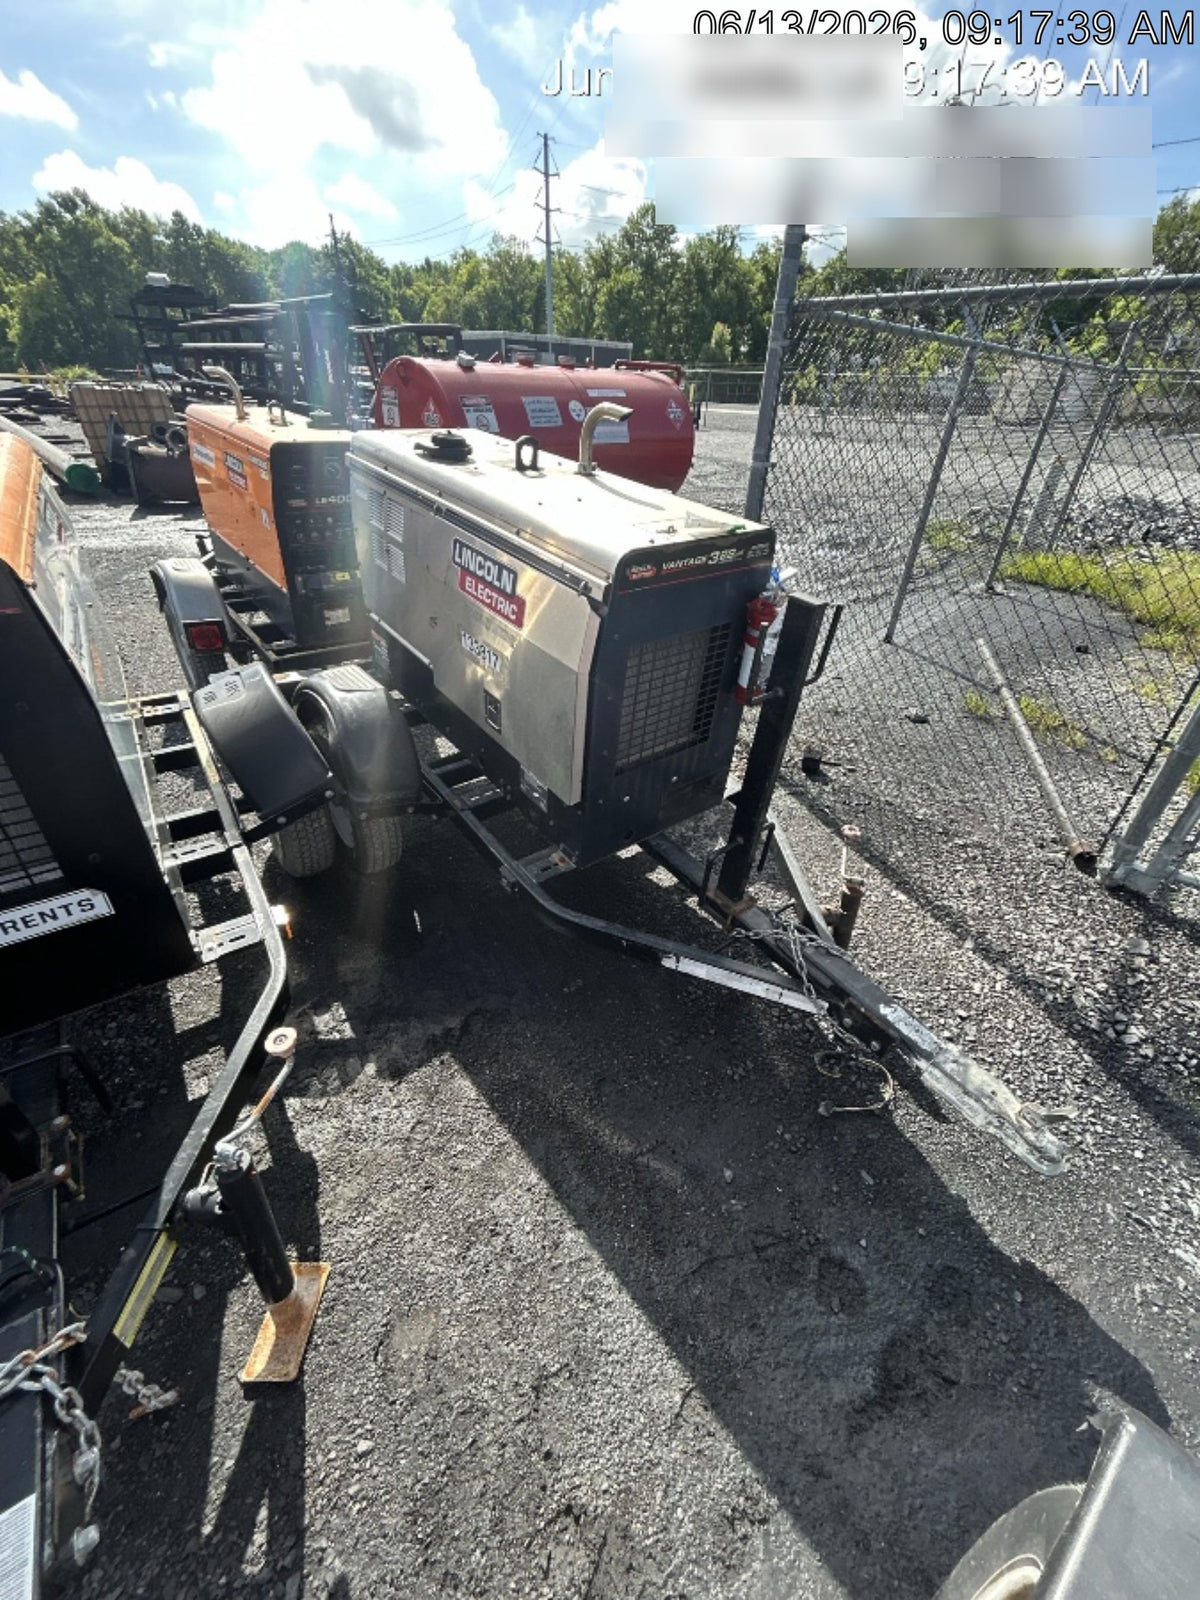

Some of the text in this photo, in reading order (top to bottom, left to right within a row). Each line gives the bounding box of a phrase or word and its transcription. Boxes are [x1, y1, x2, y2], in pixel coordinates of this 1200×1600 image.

[453, 542, 514, 594] LINCOLN
[465, 577, 518, 620] ELECTRIC
[0, 897, 95, 936] RENTS
